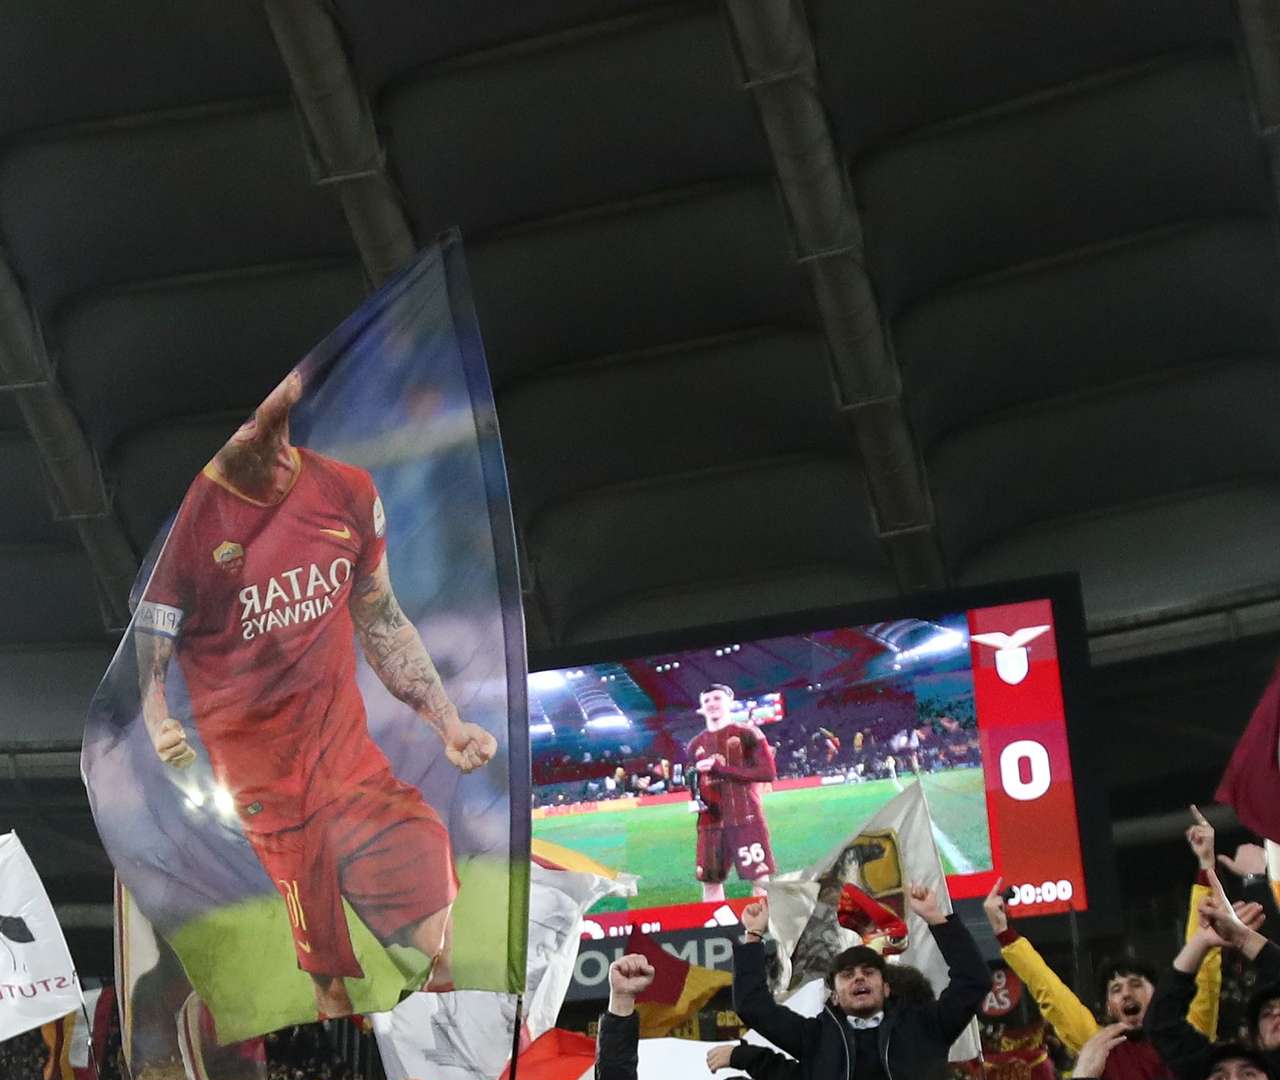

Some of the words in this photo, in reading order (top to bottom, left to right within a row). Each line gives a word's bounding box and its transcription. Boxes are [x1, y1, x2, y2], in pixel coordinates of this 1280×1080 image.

[1000, 740, 1051, 801] 0
[738, 843, 766, 867] 56
[609, 922, 662, 937] RIYDH
